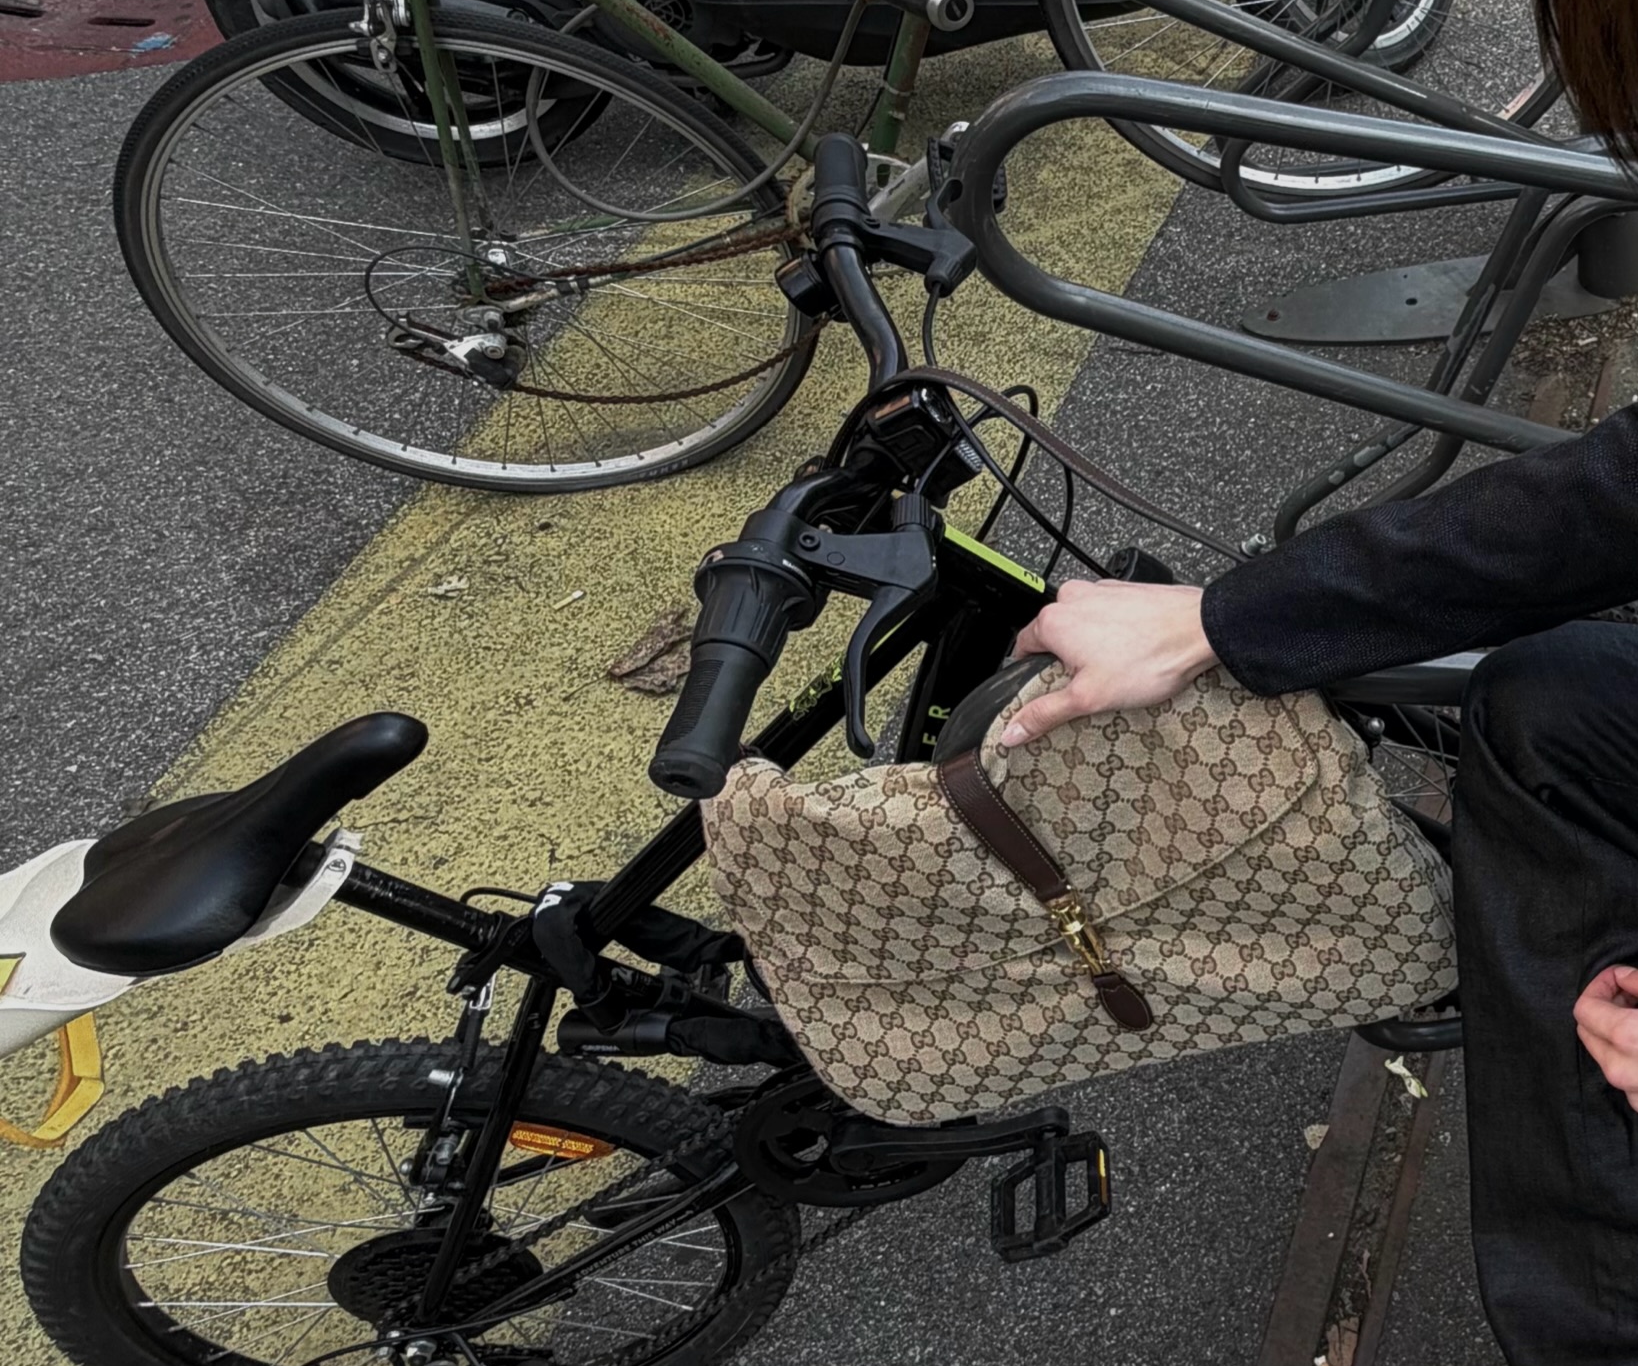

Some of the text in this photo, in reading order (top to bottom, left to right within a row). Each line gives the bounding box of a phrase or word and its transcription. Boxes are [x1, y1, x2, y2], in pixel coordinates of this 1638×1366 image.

[575, 1217, 677, 1279] ADVENTURE THIS WAY
